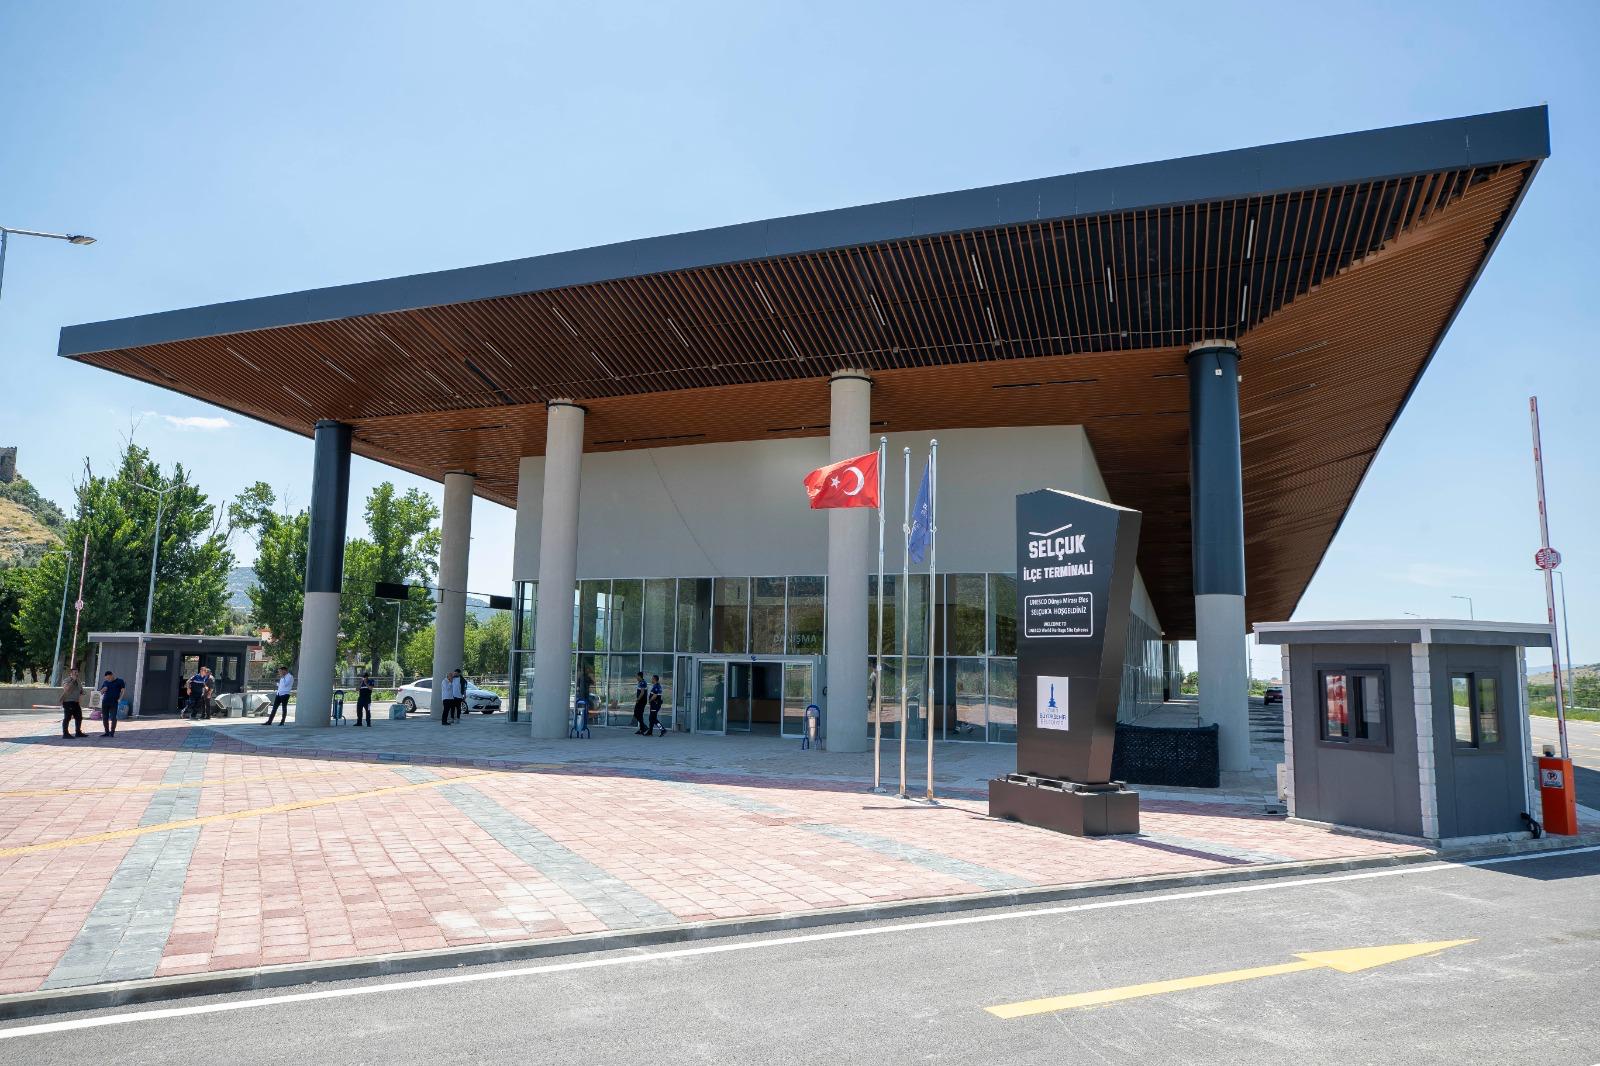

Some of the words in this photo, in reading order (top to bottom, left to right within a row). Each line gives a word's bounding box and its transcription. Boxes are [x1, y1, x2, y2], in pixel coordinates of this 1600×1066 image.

[1028, 535, 1086, 561] SELÇUK
[1023, 566, 1042, 582] İLÇE
[1044, 560, 1093, 578] TERMİNALİ
